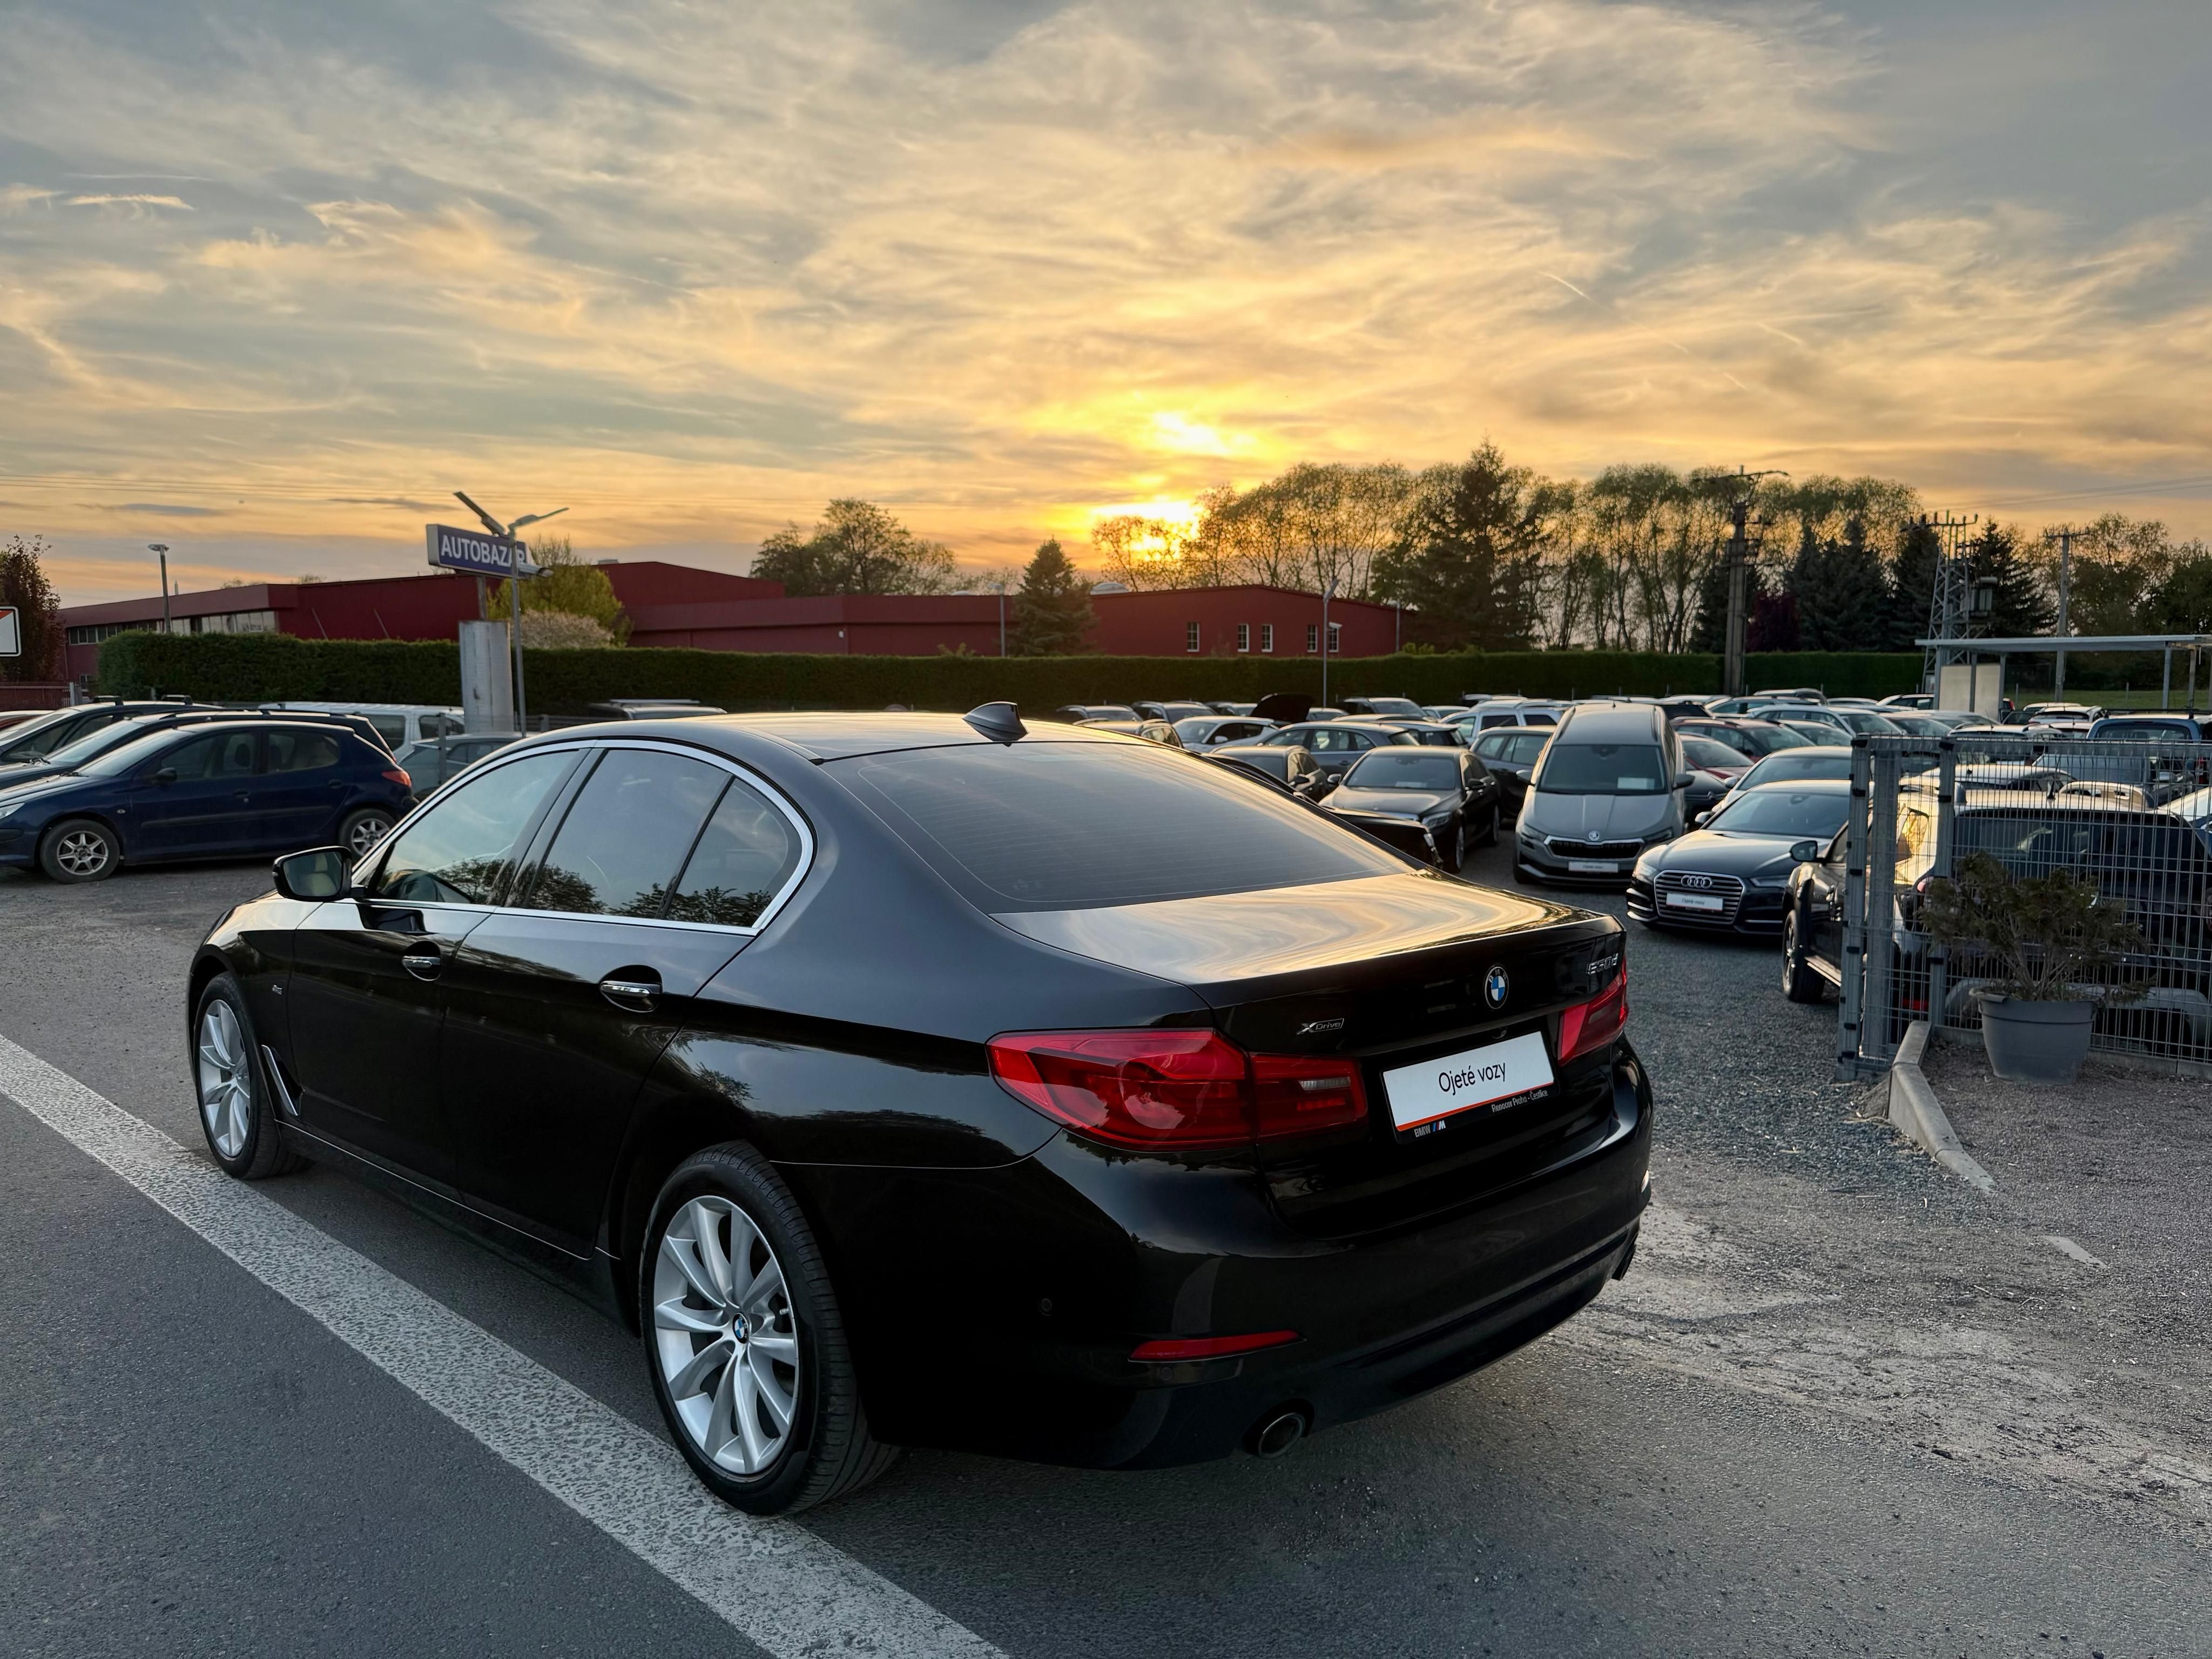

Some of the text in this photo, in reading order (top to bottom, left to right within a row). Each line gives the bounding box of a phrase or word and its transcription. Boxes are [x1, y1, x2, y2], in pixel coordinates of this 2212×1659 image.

[1439, 1063, 1506, 1096] Ojeté vozy
[1491, 1101, 1513, 1112] Renocar
[1513, 1096, 1528, 1106] Praha
[1414, 1124, 1431, 1138] BMW
